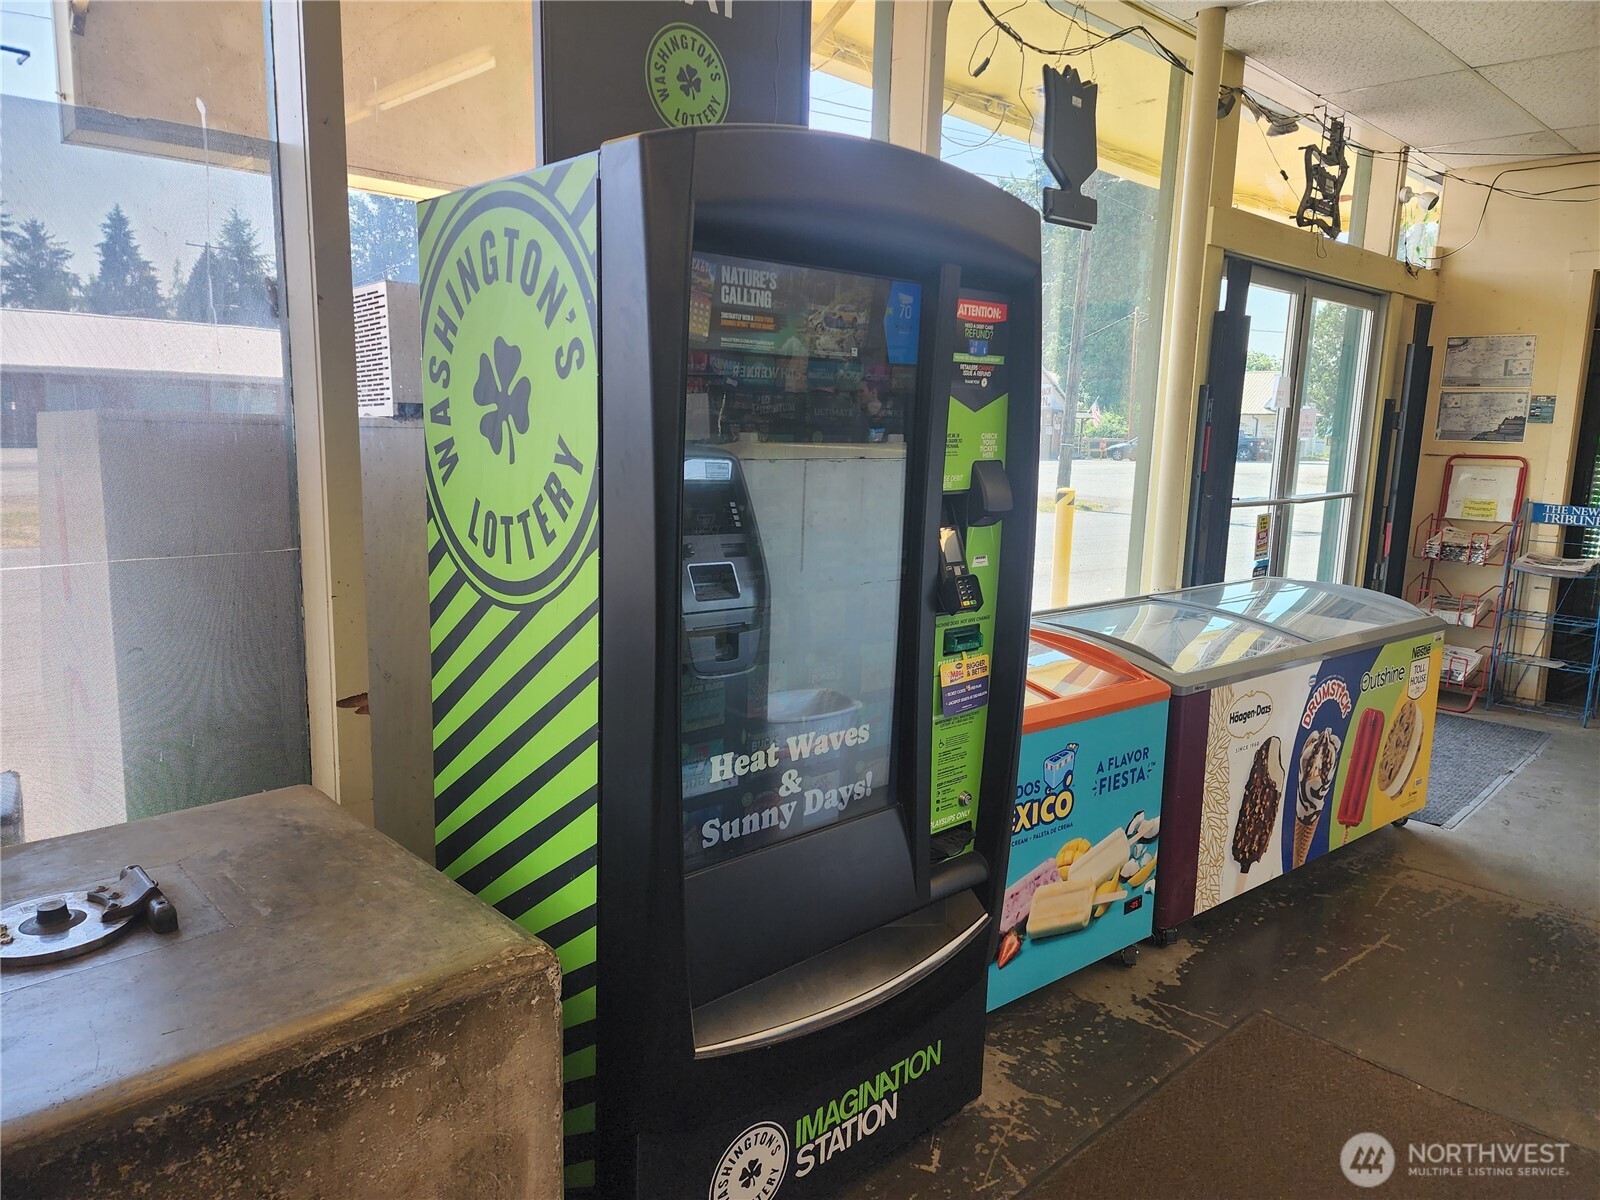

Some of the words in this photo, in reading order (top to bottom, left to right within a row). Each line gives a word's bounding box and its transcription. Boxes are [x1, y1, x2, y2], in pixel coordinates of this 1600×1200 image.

[654, 34, 721, 103] WASHINGTON'S
[674, 95, 721, 126] LOTTERY
[721, 265, 777, 290] NATURE'S
[721, 285, 772, 309] CALLING
[899, 304, 912, 320] 70
[958, 303, 1001, 320] ATTENTION:
[964, 329, 994, 340] REFUND?
[429, 227, 585, 487] WASHINGTON'S
[981, 432, 998, 440] CHECK
[467, 433, 584, 565] LOTTERY
[1544, 504, 1569, 514] THE
[1571, 506, 1600, 517] NEW
[1542, 512, 1600, 526] TRIBUNE
[966, 659, 986, 670] BIGGER
[971, 666, 988, 676] BETTER
[1414, 664, 1426, 675] TOLL
[1361, 667, 1405, 692] Outshine
[1410, 673, 1427, 686] HOUSE
[1229, 704, 1271, 725] Häagen-Dazs
[709, 742, 780, 784] Heat
[786, 723, 870, 762] Waves
[1096, 760, 1104, 775] A
[1107, 746, 1150, 773] FLAVOR
[1235, 745, 1249, 753] SINCE
[778, 769, 803, 797] &
[1098, 765, 1146, 795] FIESTA
[701, 800, 797, 849] Sunny
[803, 770, 873, 817] Days!
[956, 808, 972, 820] ONLY
[1013, 790, 1073, 833] XICO
[1011, 837, 1028, 847] CREAM
[1032, 828, 1050, 841] PALETA
[1050, 827, 1057, 835] DE
[1057, 822, 1073, 833] CREMA
[795, 1039, 942, 1149] IMAGINATION
[795, 1092, 898, 1178] STATION
[717, 1131, 782, 1200] ASHINGTON'S
